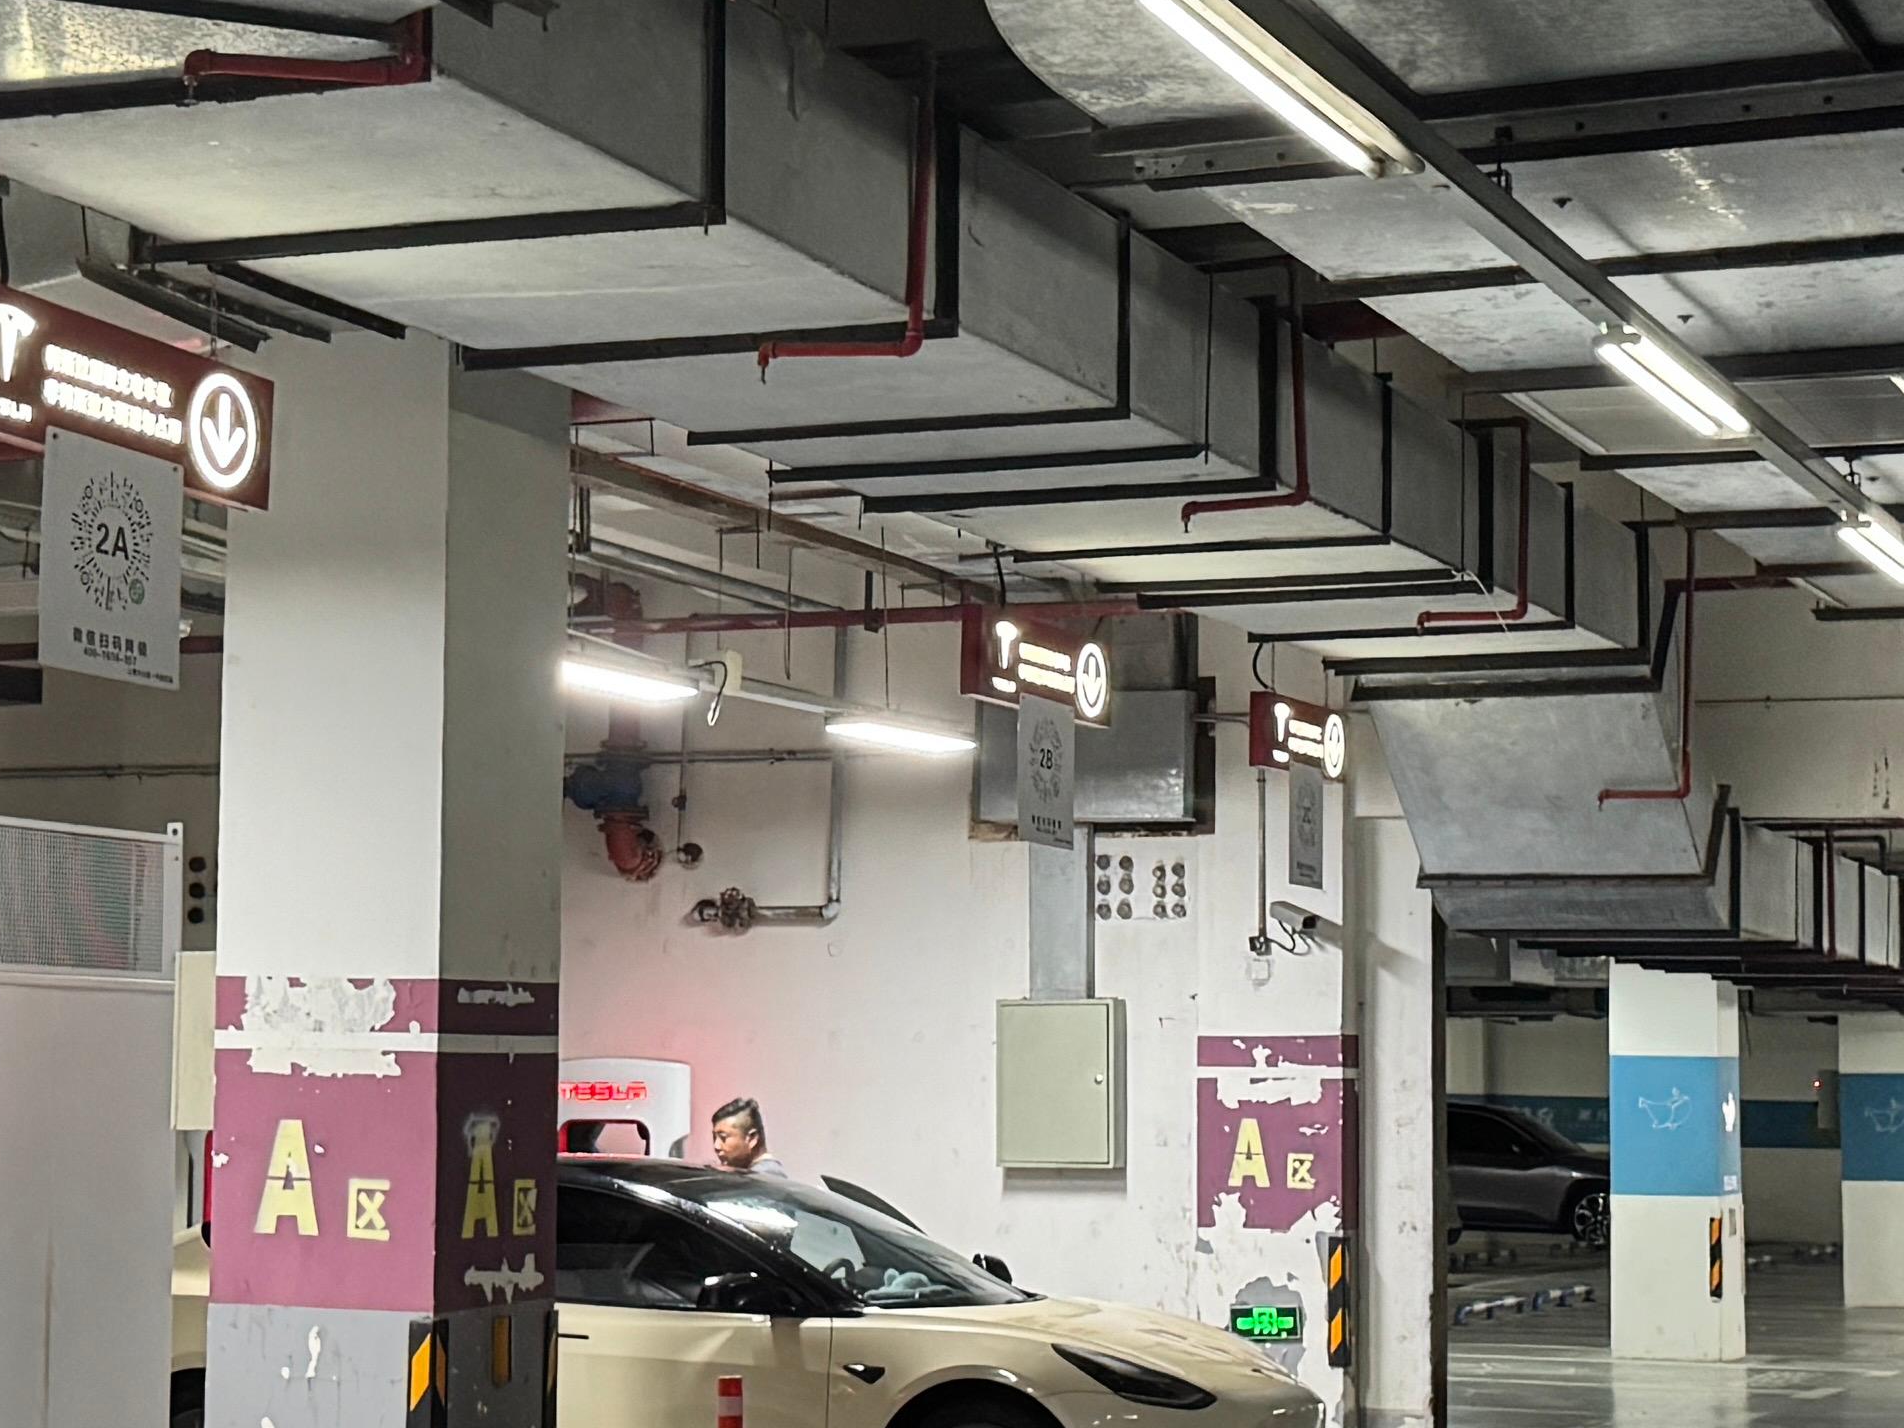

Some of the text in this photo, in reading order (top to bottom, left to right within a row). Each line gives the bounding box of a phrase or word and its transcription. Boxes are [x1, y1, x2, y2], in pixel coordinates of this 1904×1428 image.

[96, 522, 130, 562] 2A
[1039, 748, 1053, 770] 2B
[559, 1081, 648, 1102] TESLA
